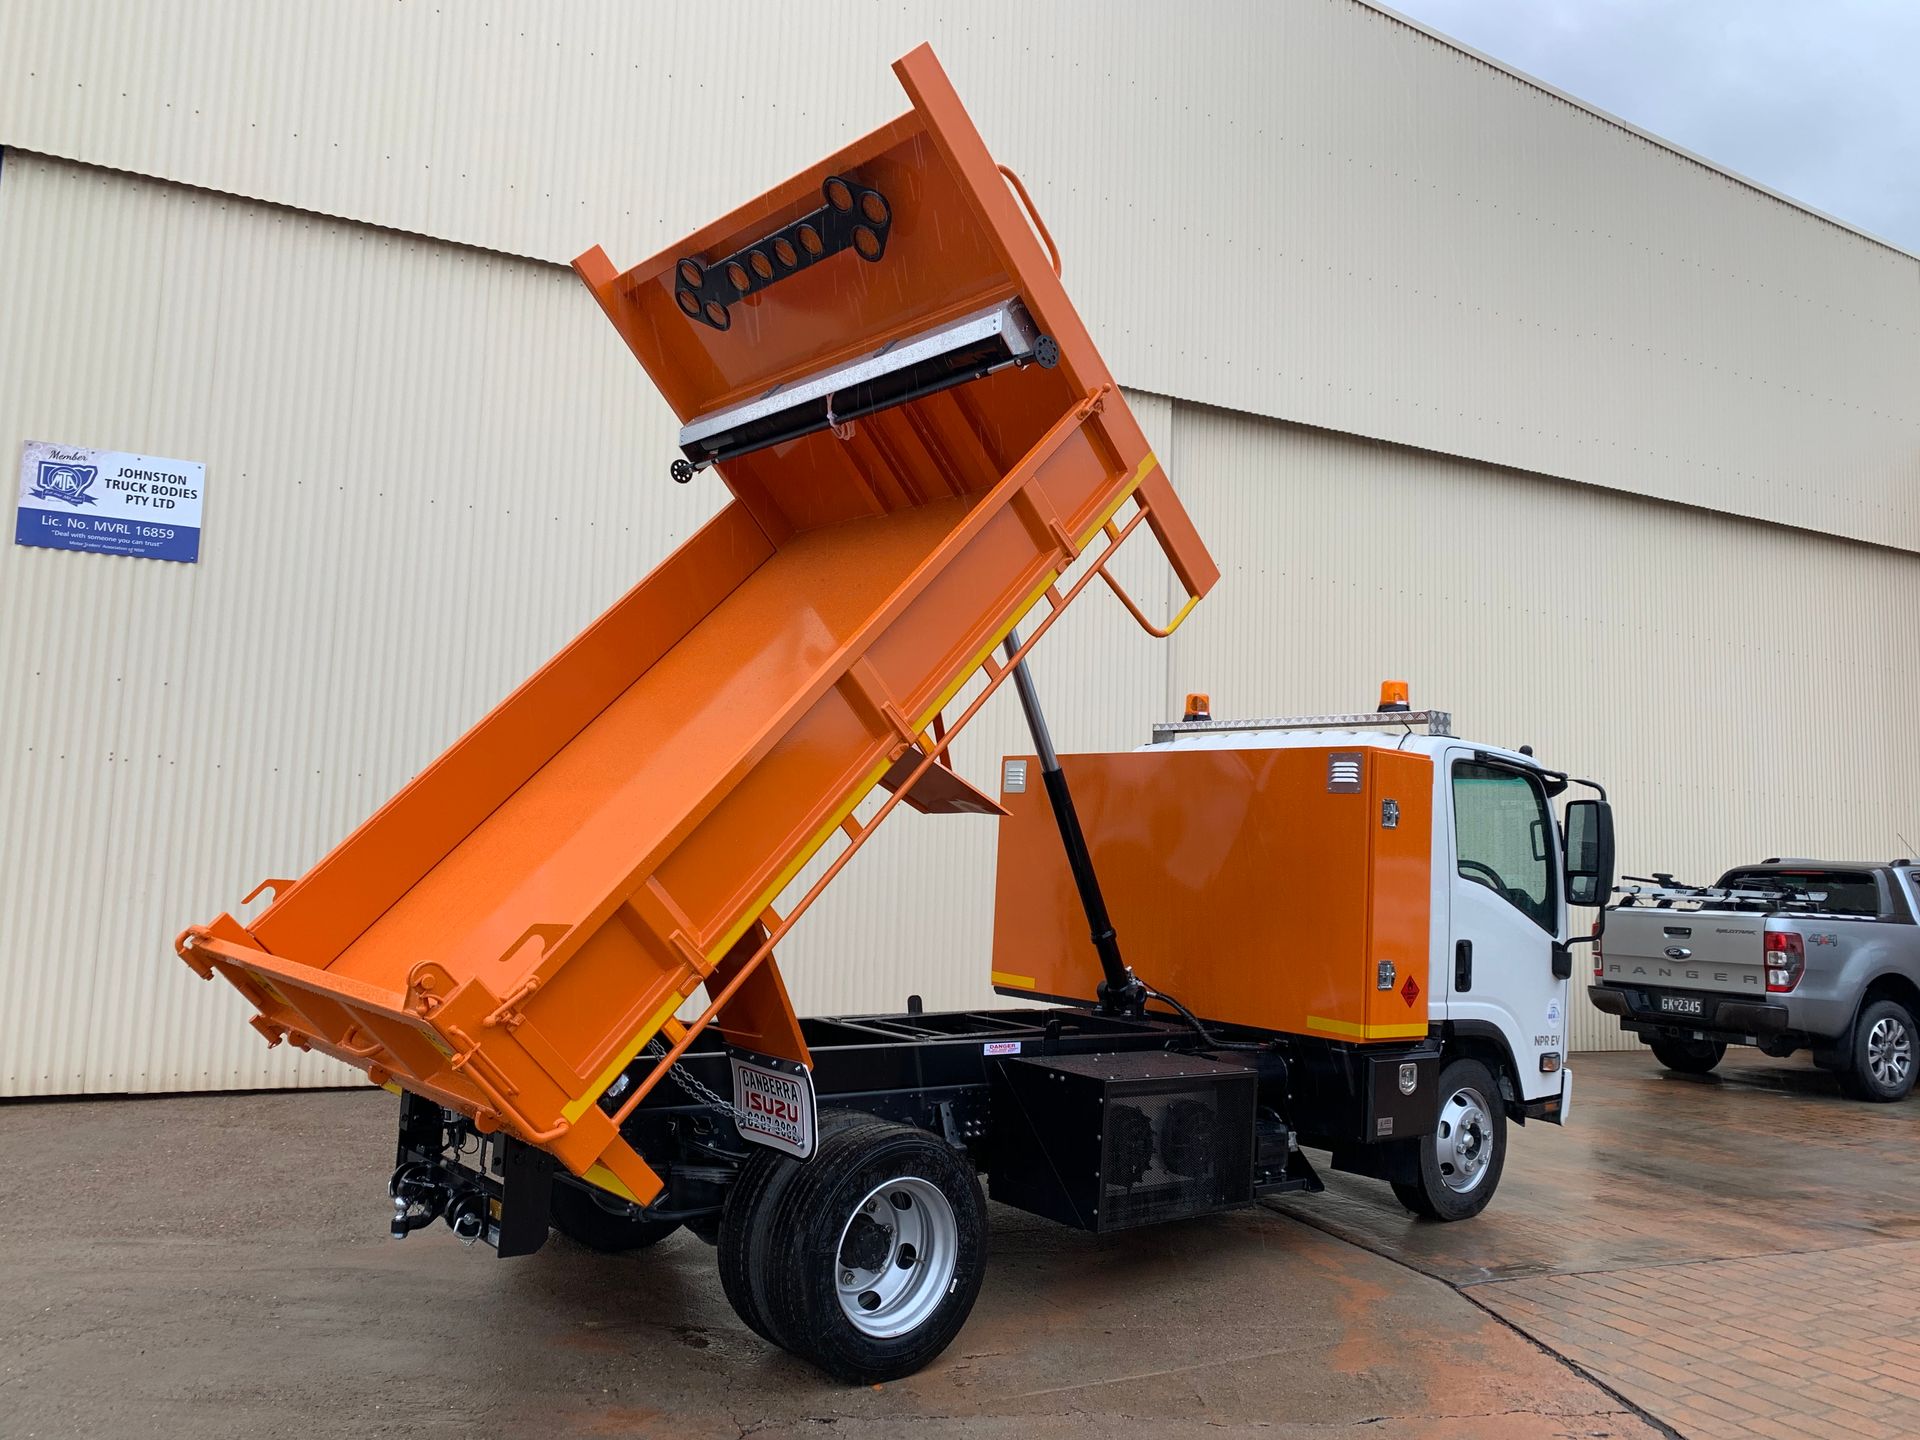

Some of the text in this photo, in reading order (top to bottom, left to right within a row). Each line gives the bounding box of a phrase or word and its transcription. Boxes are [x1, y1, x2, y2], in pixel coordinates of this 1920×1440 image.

[48, 449, 88, 461] Member
[50, 471, 78, 491] MTA
[117, 467, 187, 486] JOHNSTON
[104, 478, 198, 500] TRUCK BODIES
[125, 494, 176, 510] PTY LTD
[41, 515, 175, 540] Lic. No. MVRL 16859
[87, 534, 117, 542] someone
[118, 537, 130, 545] you
[1609, 963, 1758, 985] RANGER
[1534, 1035, 1560, 1047] NPR EV
[743, 1070, 799, 1102] CANBERRA
[745, 1090, 798, 1123] ISUZU
